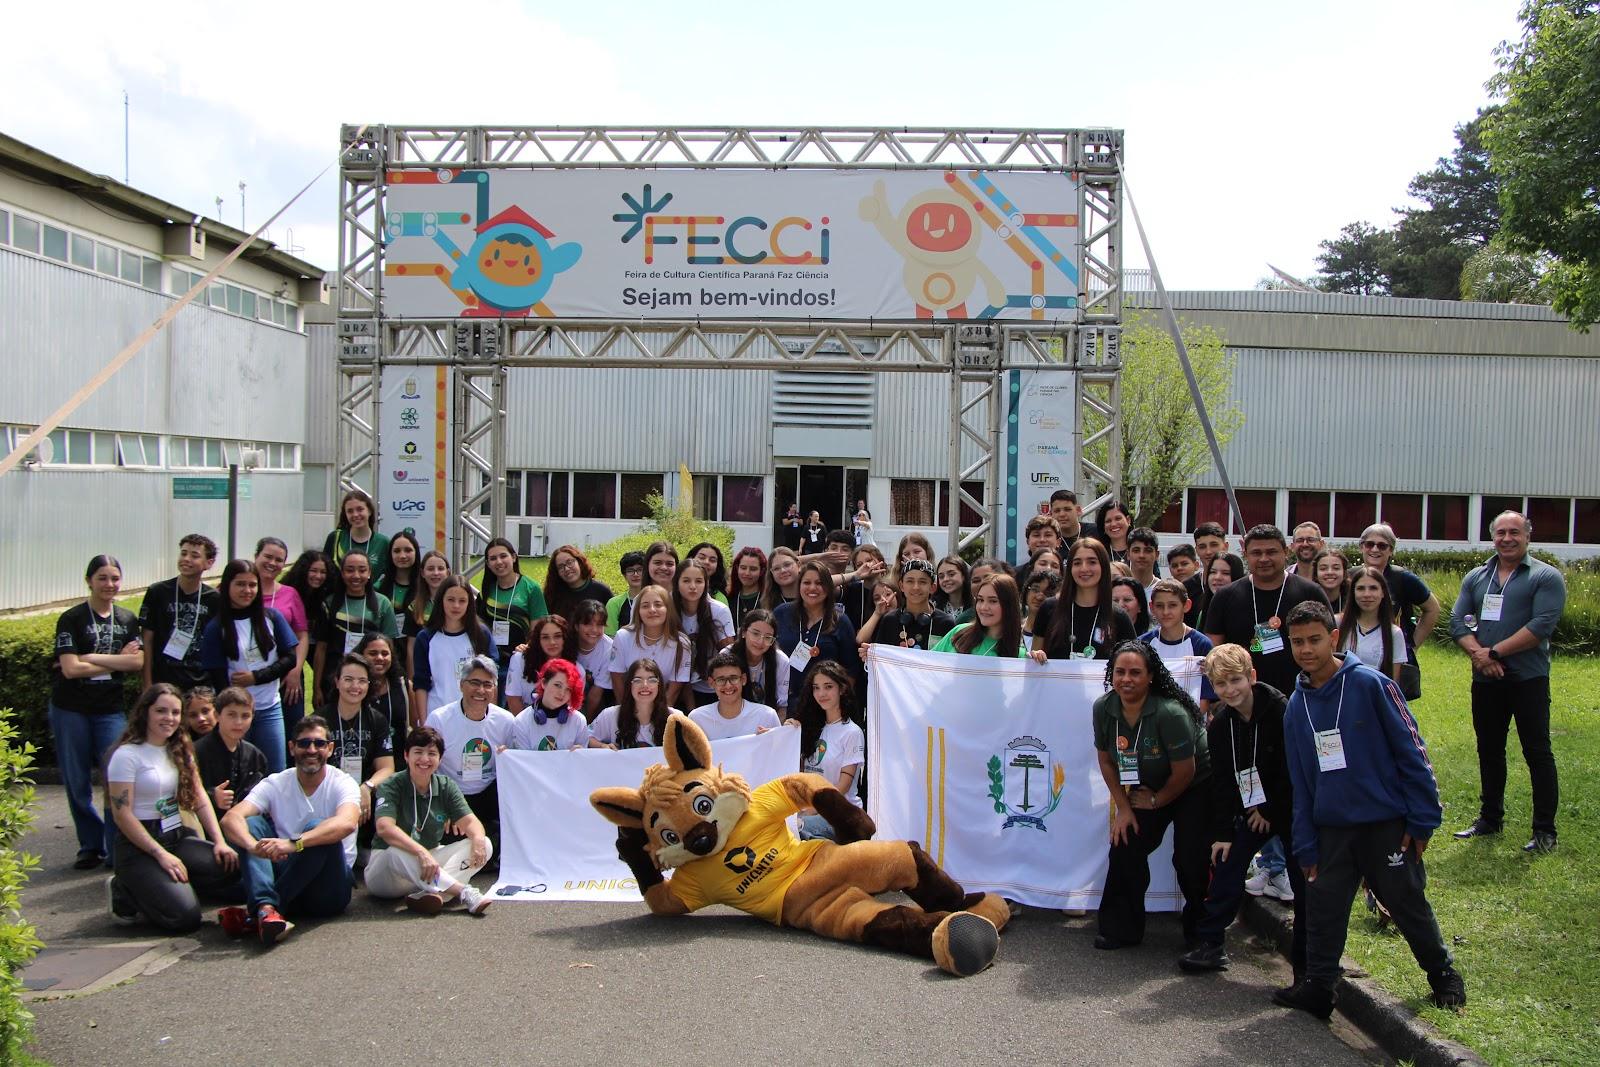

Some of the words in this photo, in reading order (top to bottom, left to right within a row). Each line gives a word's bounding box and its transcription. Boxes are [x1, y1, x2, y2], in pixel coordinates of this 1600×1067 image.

[624, 270, 647, 279] Feira
[649, 270, 661, 279] de
[663, 270, 696, 279] Cultura
[698, 270, 740, 279] Científica
[743, 271, 775, 279] Paraná
[777, 271, 793, 279] Faz
[795, 271, 829, 279] Ciência
[622, 287, 692, 309] Sejam
[700, 288, 836, 306] bem-vindos!
[735, 847, 779, 895] UNICENTRO
